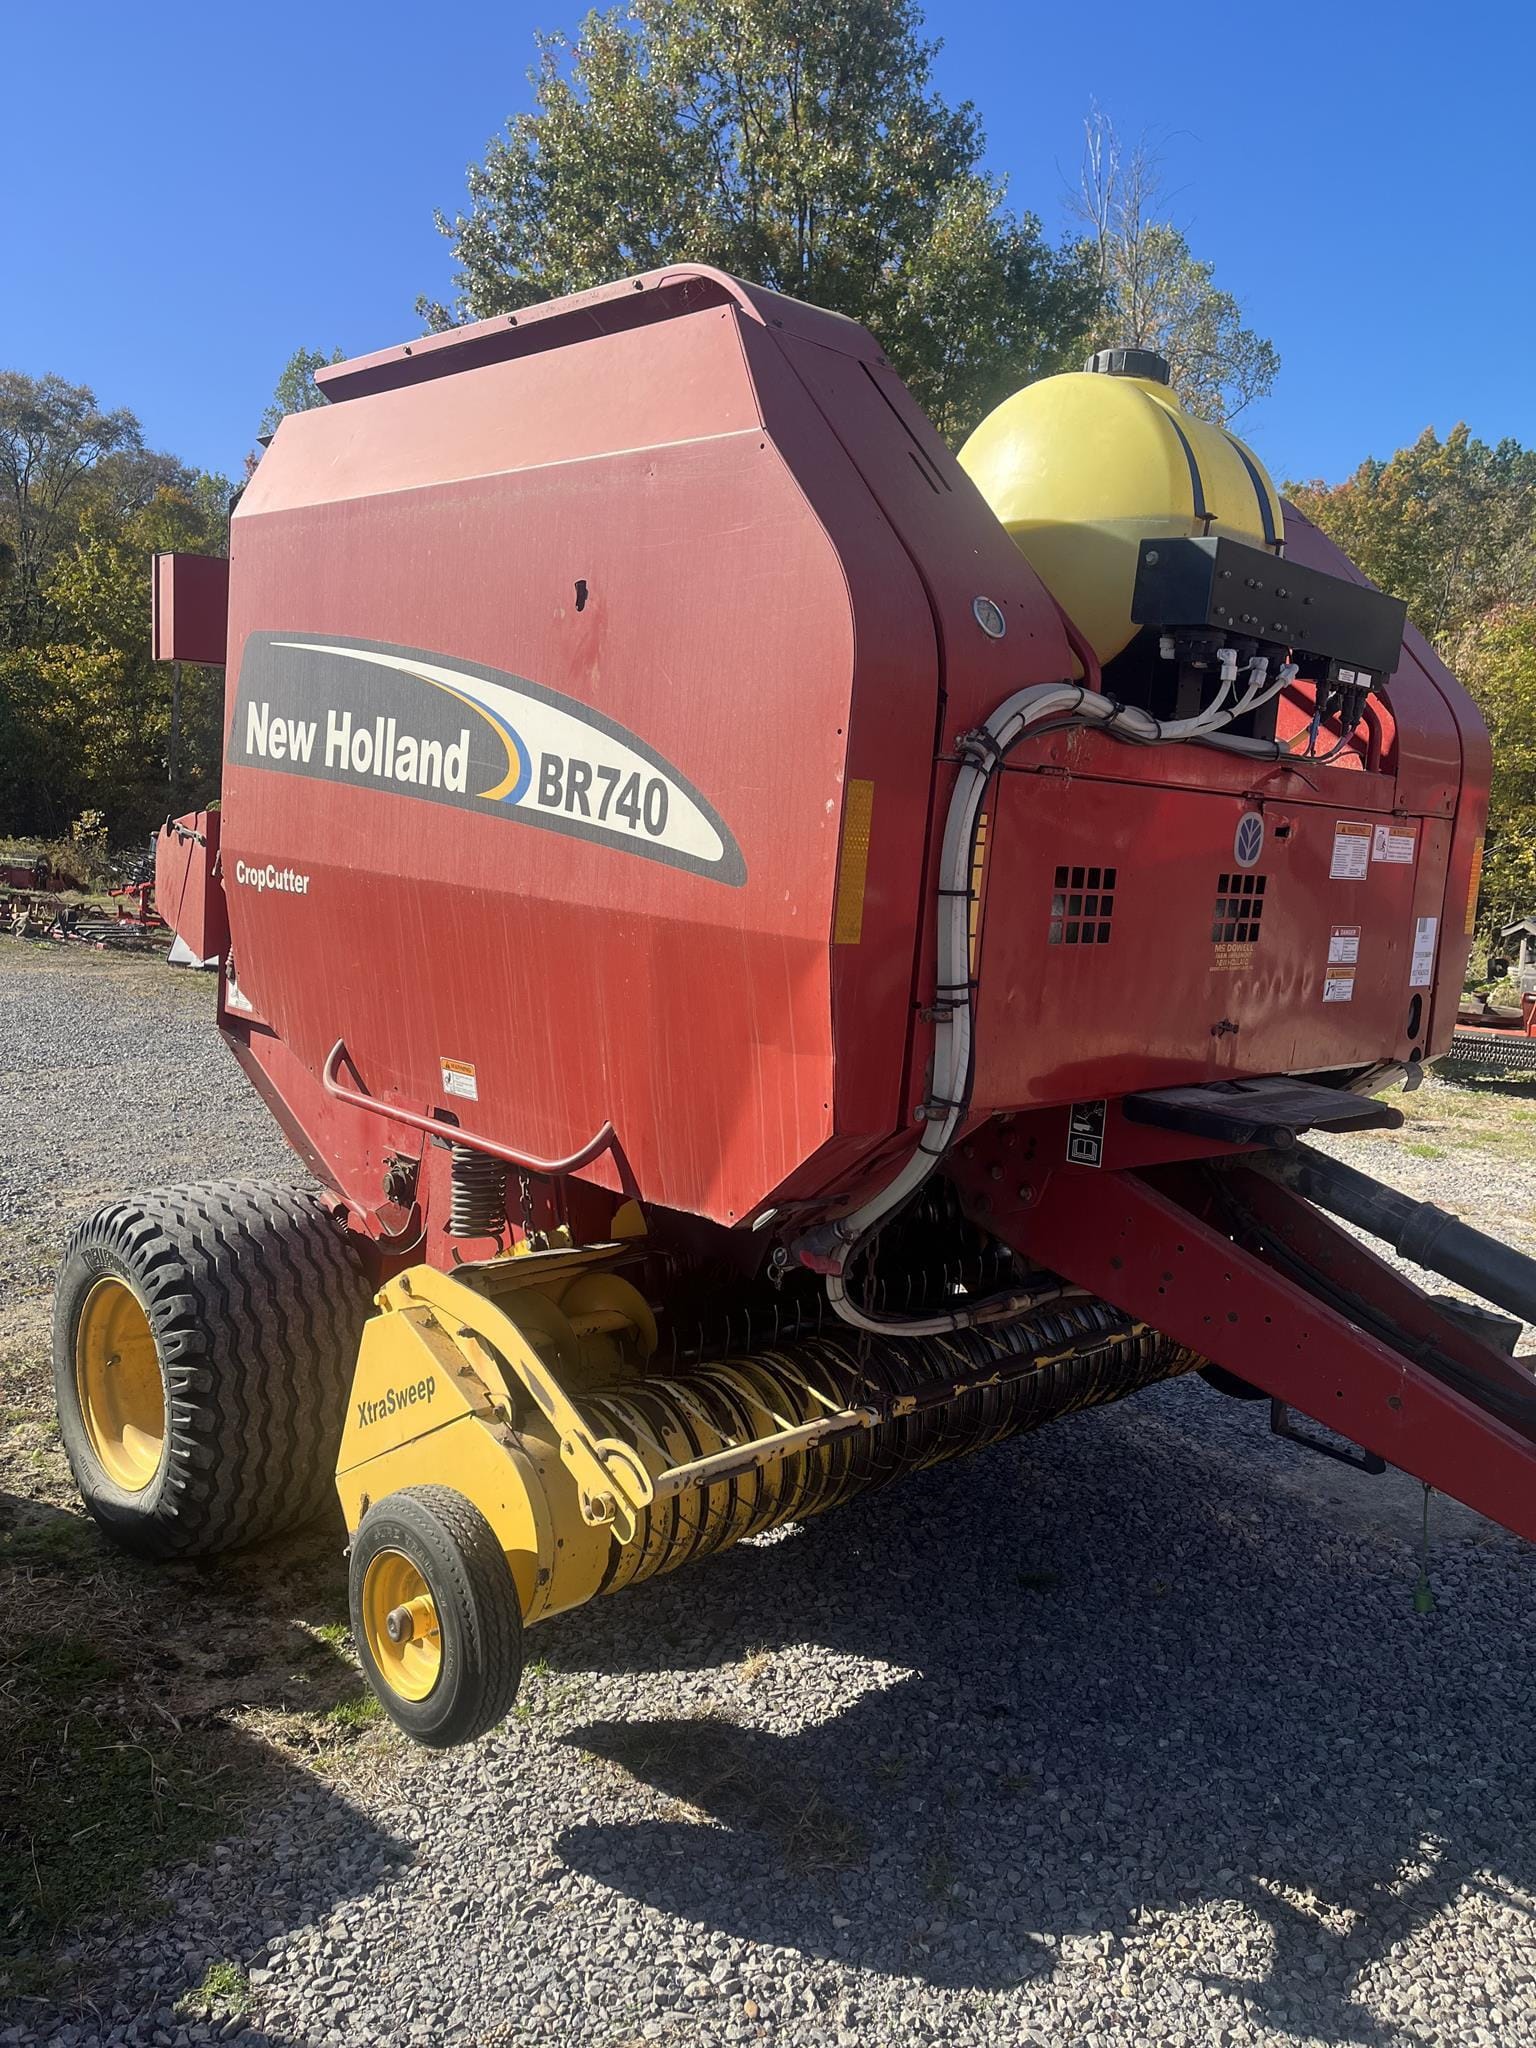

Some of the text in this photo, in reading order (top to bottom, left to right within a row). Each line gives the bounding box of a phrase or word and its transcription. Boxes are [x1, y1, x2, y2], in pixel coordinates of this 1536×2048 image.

[245, 700, 471, 793] New Holland
[537, 752, 670, 837] BR740
[235, 860, 311, 895] CropCutter
[357, 1376, 436, 1429] XtraSweep
